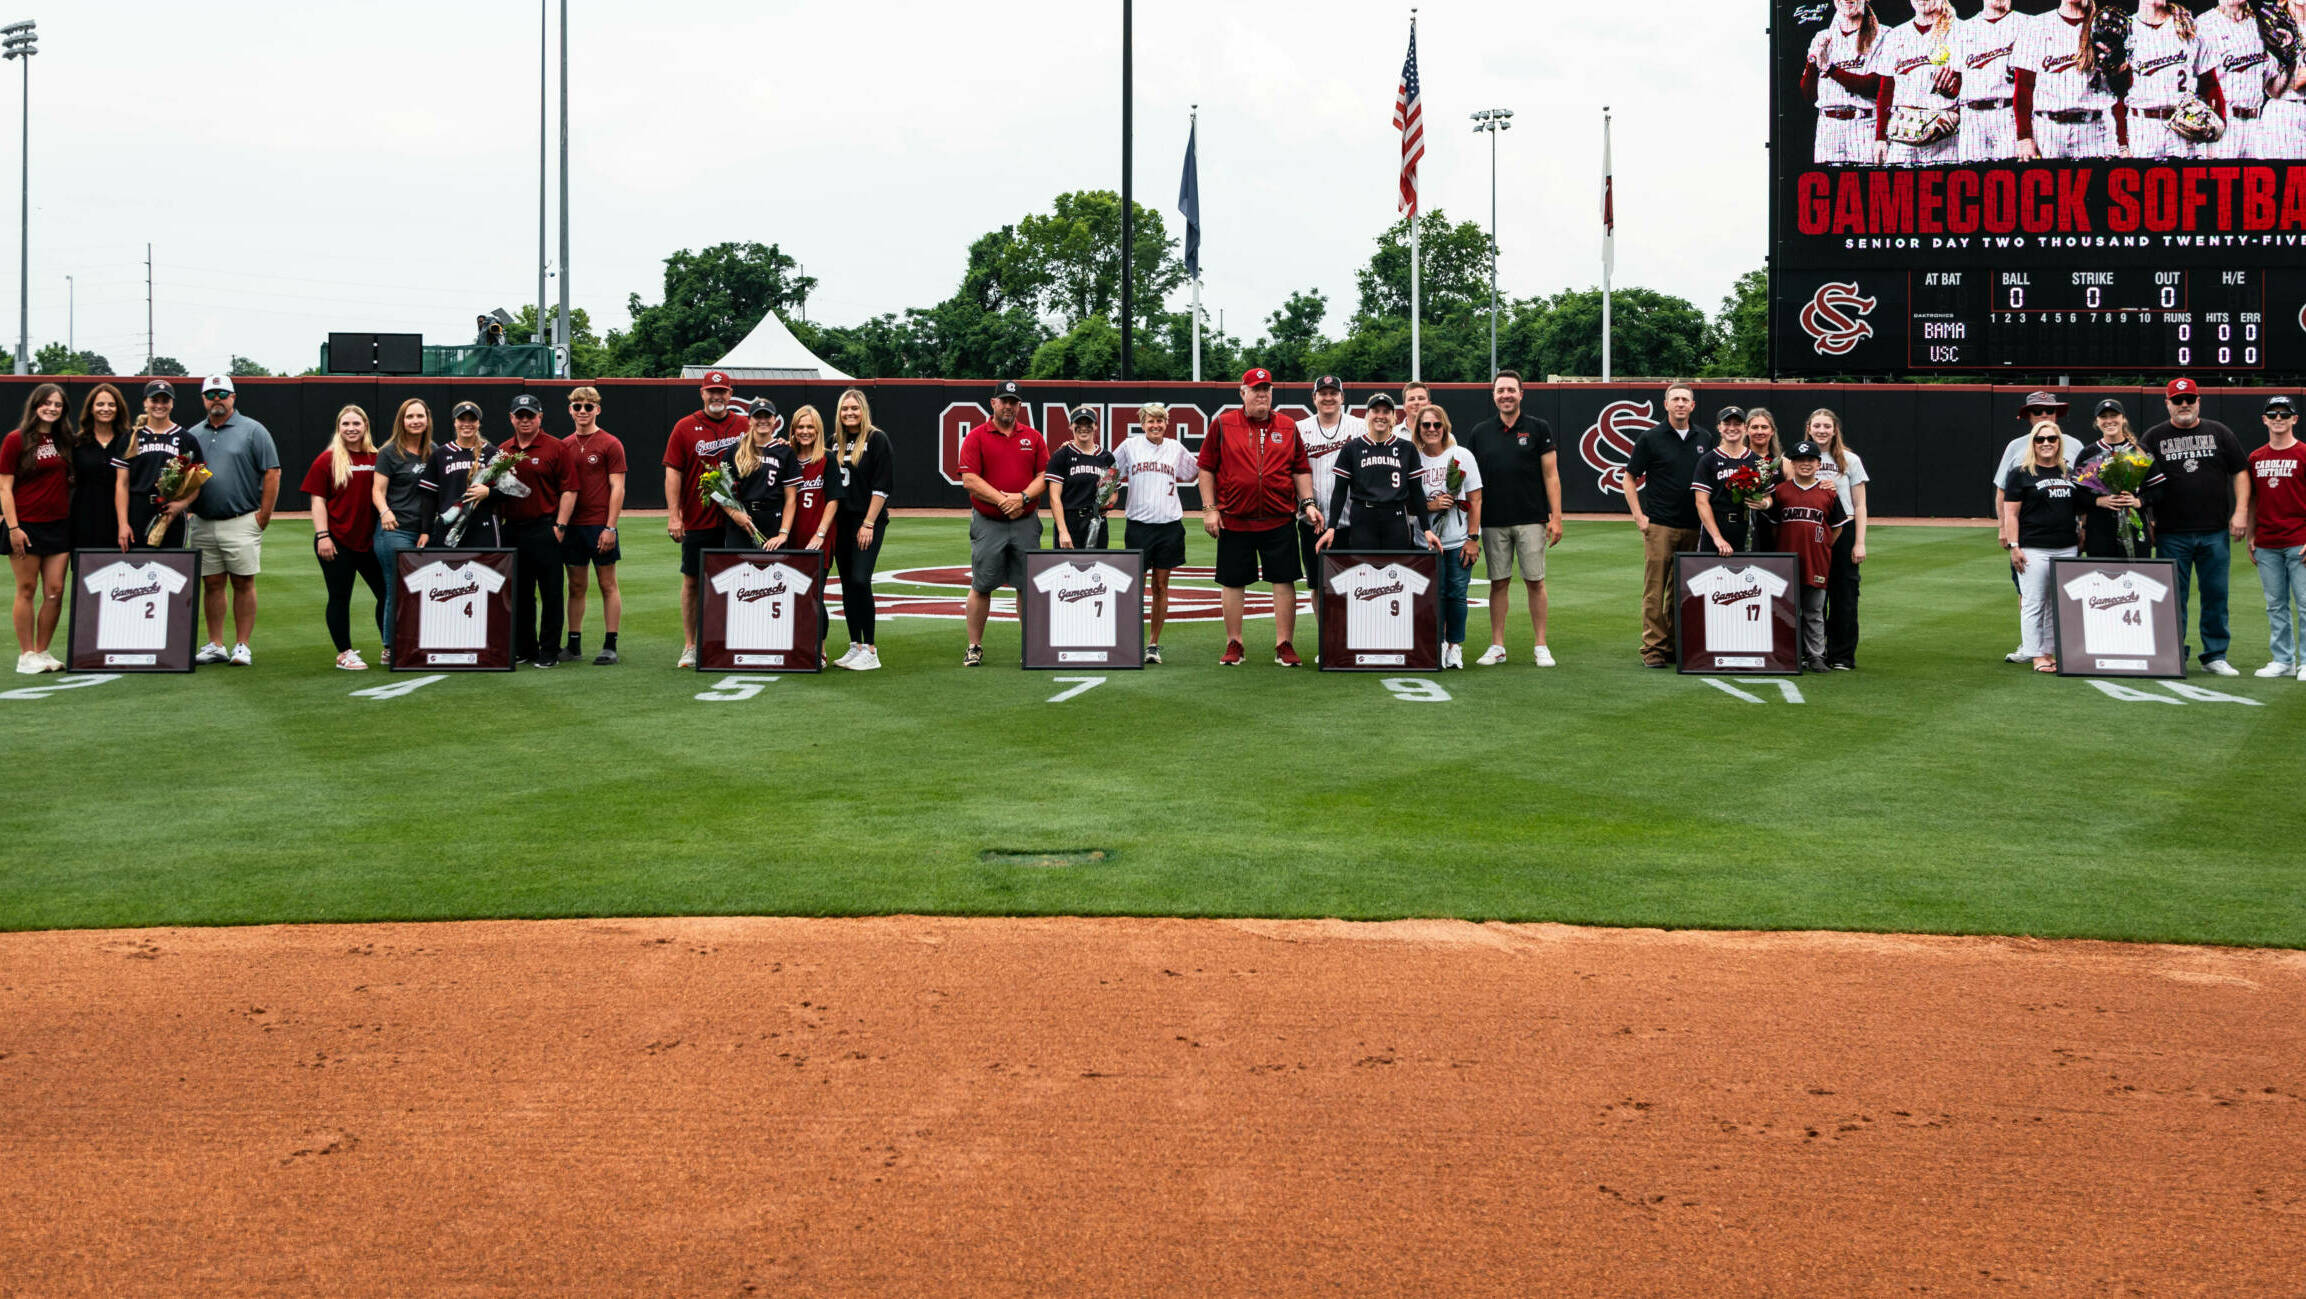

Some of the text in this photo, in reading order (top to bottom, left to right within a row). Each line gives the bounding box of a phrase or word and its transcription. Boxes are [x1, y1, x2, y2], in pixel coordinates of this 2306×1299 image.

[2177, 69, 2187, 92] 2
[1798, 168, 2093, 235] GAMECOCK
[1845, 238, 1920, 249] SENIOR
[1932, 238, 1969, 248] DAY
[1983, 237, 2025, 248] TWO
[2038, 236, 2150, 247] THOUSAND
[1925, 273, 1962, 286] AT BAT
[2002, 273, 2030, 285] BALL
[2072, 272, 2114, 285] STRIKE
[2155, 272, 2180, 285] OUT
[2222, 271, 2245, 285] H/E
[2009, 287, 2023, 308] 0
[2086, 287, 2100, 308] 0
[2161, 287, 2175, 308] 0
[1990, 312, 2261, 323] 1 2 3 4 5 6 7 8 9 10 RUNS HITS ERR
[1924, 322, 1966, 339] BAMA
[2178, 324, 2257, 341] 0 0 0
[1930, 346, 1959, 363] USC
[2178, 347, 2257, 364] 0 0 0
[172, 437, 180, 446] C
[2160, 434, 2217, 455] CAROLINA
[1392, 447, 1399, 456] C
[2166, 450, 2214, 461] SOFTBALL
[1131, 461, 1175, 479] CAROLINA
[1360, 456, 1401, 468] CAROLINA
[2255, 459, 2298, 470] CAROLINA
[767, 470, 777, 486] 5
[1391, 472, 1400, 488] 9
[2256, 468, 2292, 477] SOFTBALL
[1168, 482, 1175, 496] 7
[2048, 488, 2071, 498] MOM
[803, 492, 813, 508] 5
[111, 581, 161, 601] Gamecocks
[429, 581, 479, 601] Gamecocks
[736, 581, 787, 602] Gamecocks
[1058, 583, 1107, 602] Gamecocks
[1354, 581, 1404, 600] Gamecocks
[1712, 584, 1762, 604] Gamecocks
[2089, 590, 2139, 609] Gamecocks
[145, 602, 155, 619] 2
[464, 601, 473, 618] 4
[772, 602, 781, 619] 5
[1094, 600, 1103, 617] 7
[1390, 600, 1400, 617] 9
[1746, 604, 1760, 621] 17
[2122, 609, 2142, 626] 44
[0, 674, 122, 699] 2
[349, 675, 449, 700] 4
[695, 676, 781, 701] 5
[1046, 677, 1107, 702] 7
[1380, 678, 1452, 702] 9
[1701, 678, 1805, 704] 17
[2084, 680, 2266, 706] 44
